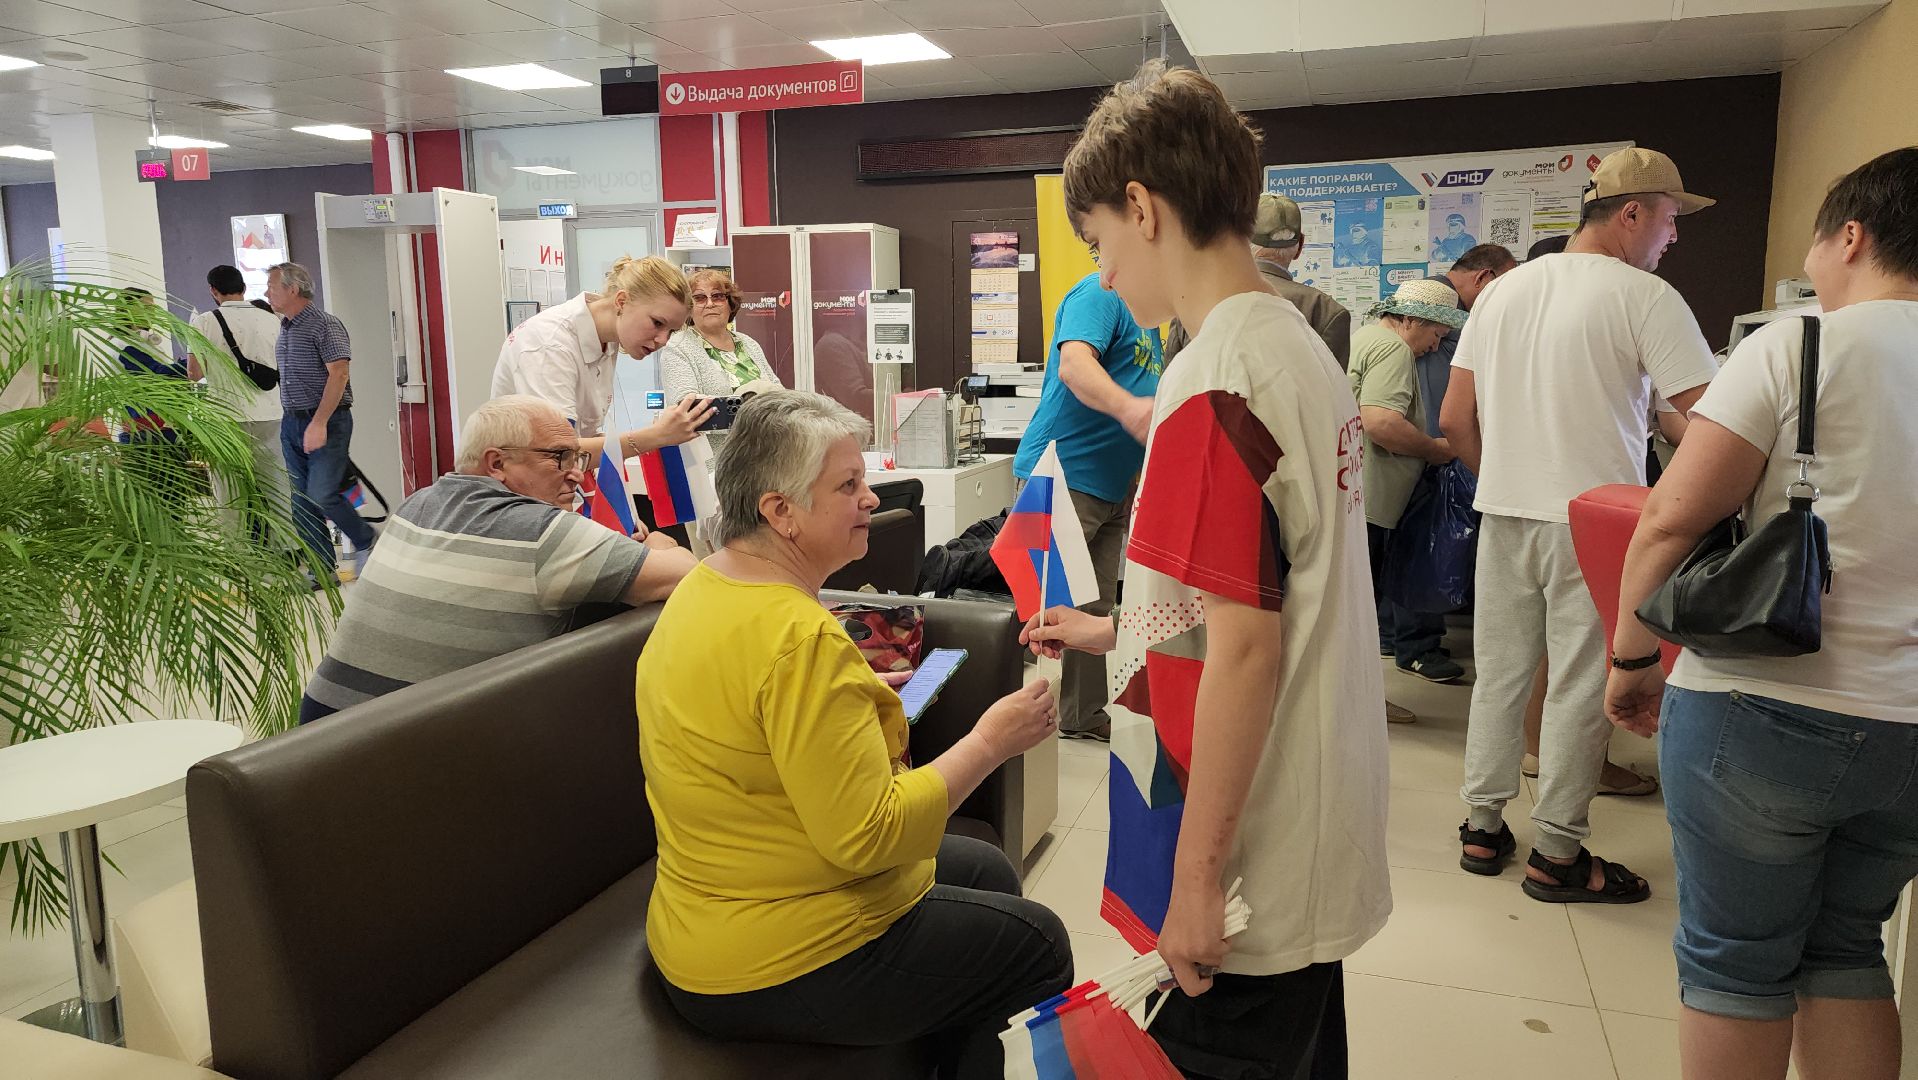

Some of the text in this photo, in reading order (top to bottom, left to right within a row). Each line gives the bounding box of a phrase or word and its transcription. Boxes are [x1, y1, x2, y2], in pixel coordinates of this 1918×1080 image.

[625, 69, 632, 78] 8
[688, 79, 837, 103] Выдача документов
[182, 154, 198, 171] 07
[1269, 172, 1373, 187] КАКИЕ ПОПРАВКИ
[1447, 171, 1484, 185] ОНФ
[1289, 183, 1398, 197] ПОДДЕРЖИВАЕТЕ?
[740, 302, 776, 310] окументы
